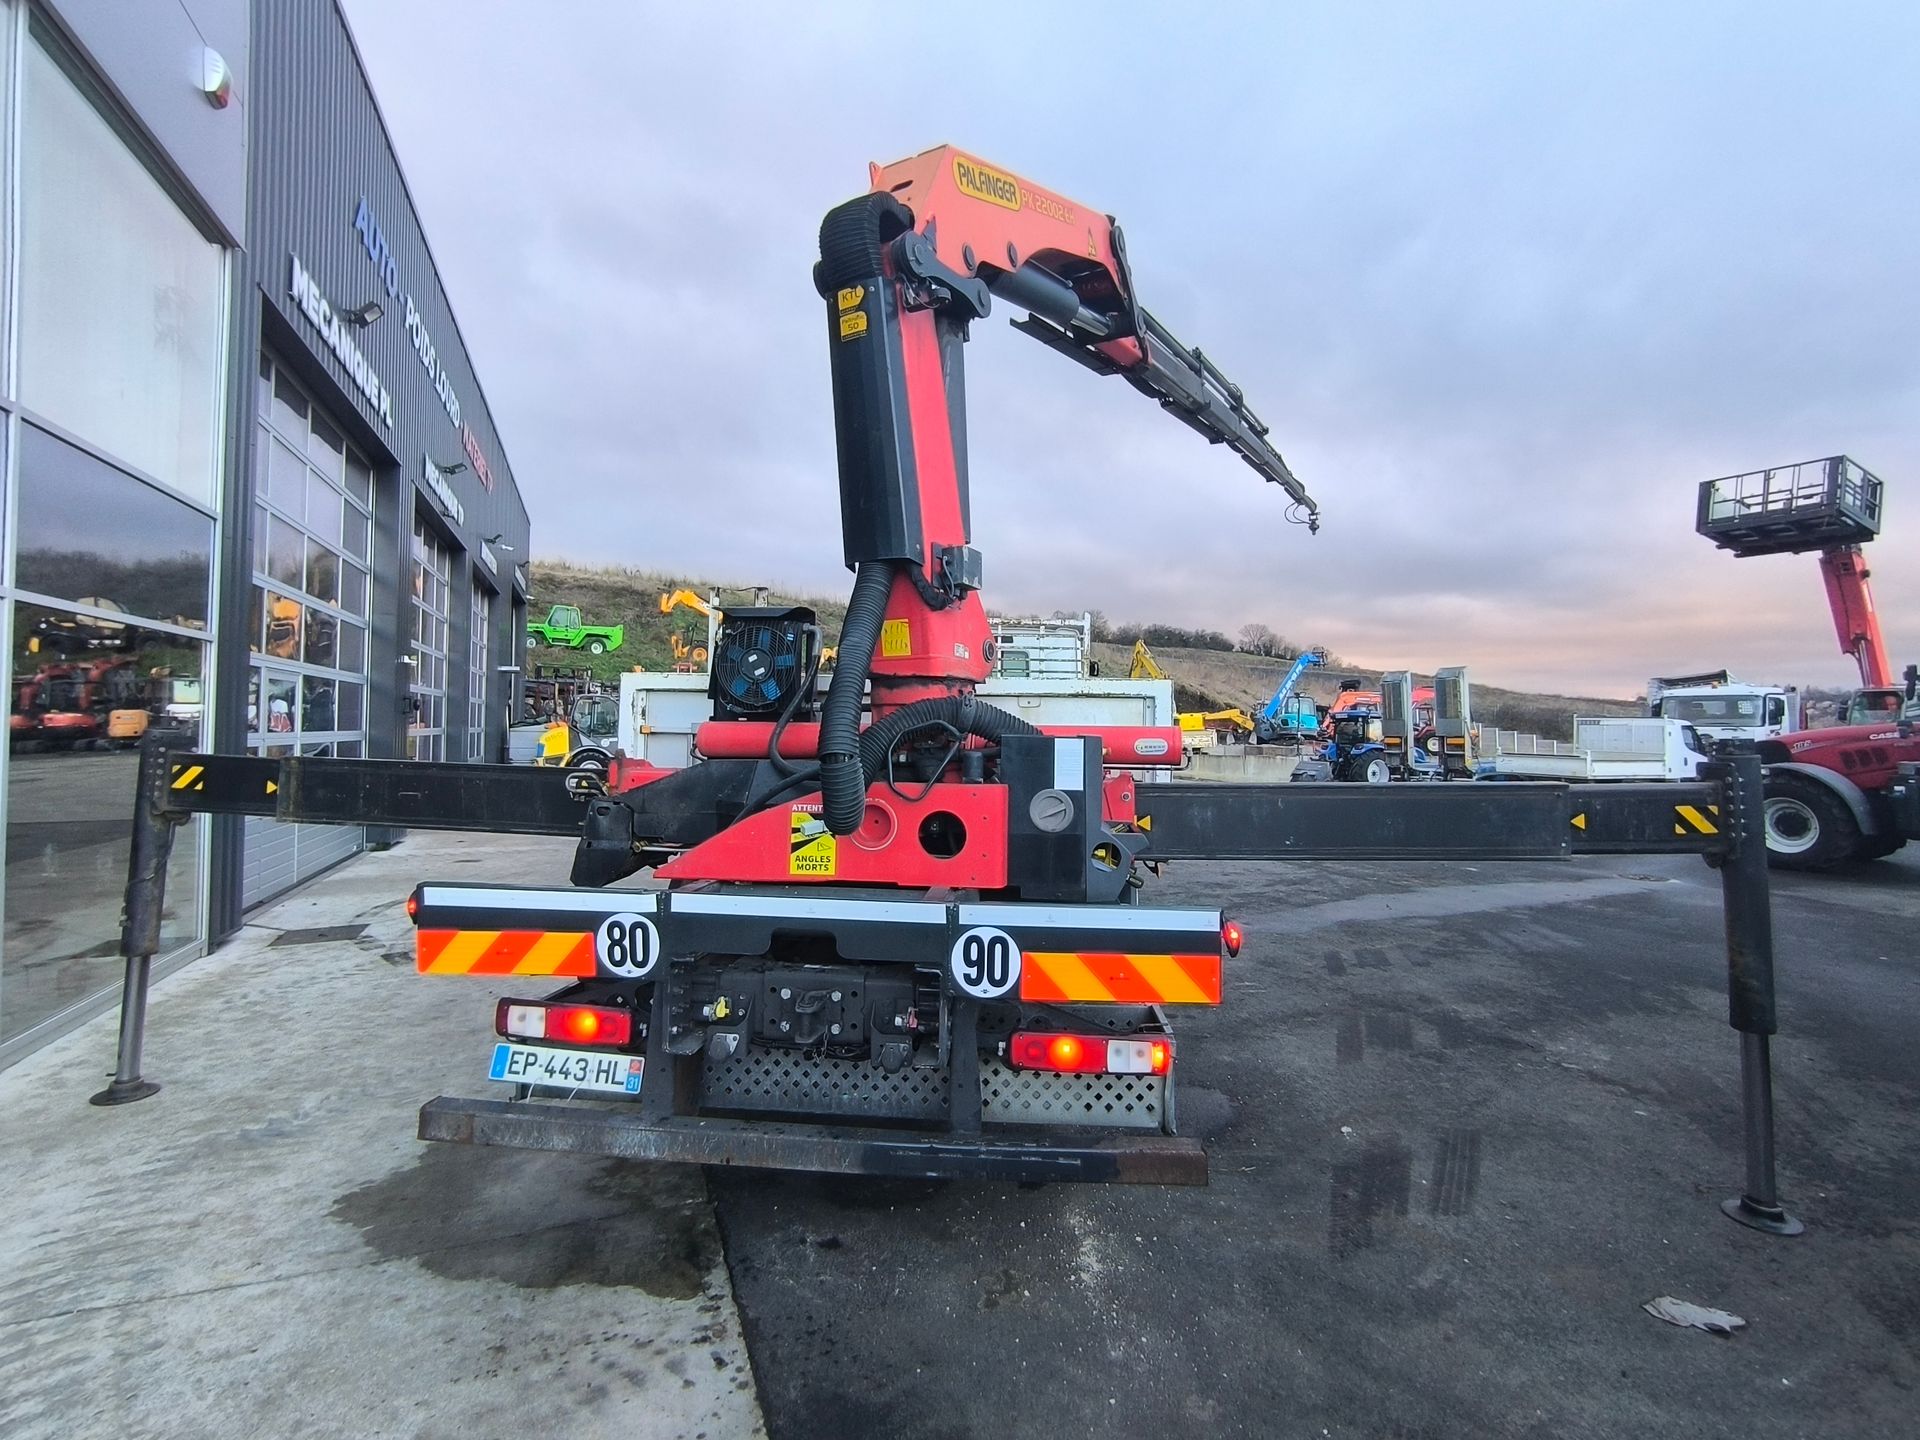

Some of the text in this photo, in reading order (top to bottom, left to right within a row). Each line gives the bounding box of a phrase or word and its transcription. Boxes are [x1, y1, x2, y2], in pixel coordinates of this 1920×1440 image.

[957, 162, 1018, 205] PALFINGER
[353, 197, 398, 298] AUTO
[404, 294, 436, 380] POIDS
[435, 364, 461, 430] LOURD
[847, 322, 860, 331] 50
[290, 253, 393, 429] MECANIQUE PL
[792, 804, 824, 812] ATTENT
[794, 855, 831, 863] ANGLES
[606, 920, 651, 969] 80
[963, 934, 1010, 988] 90
[628, 1076, 639, 1090] 31
